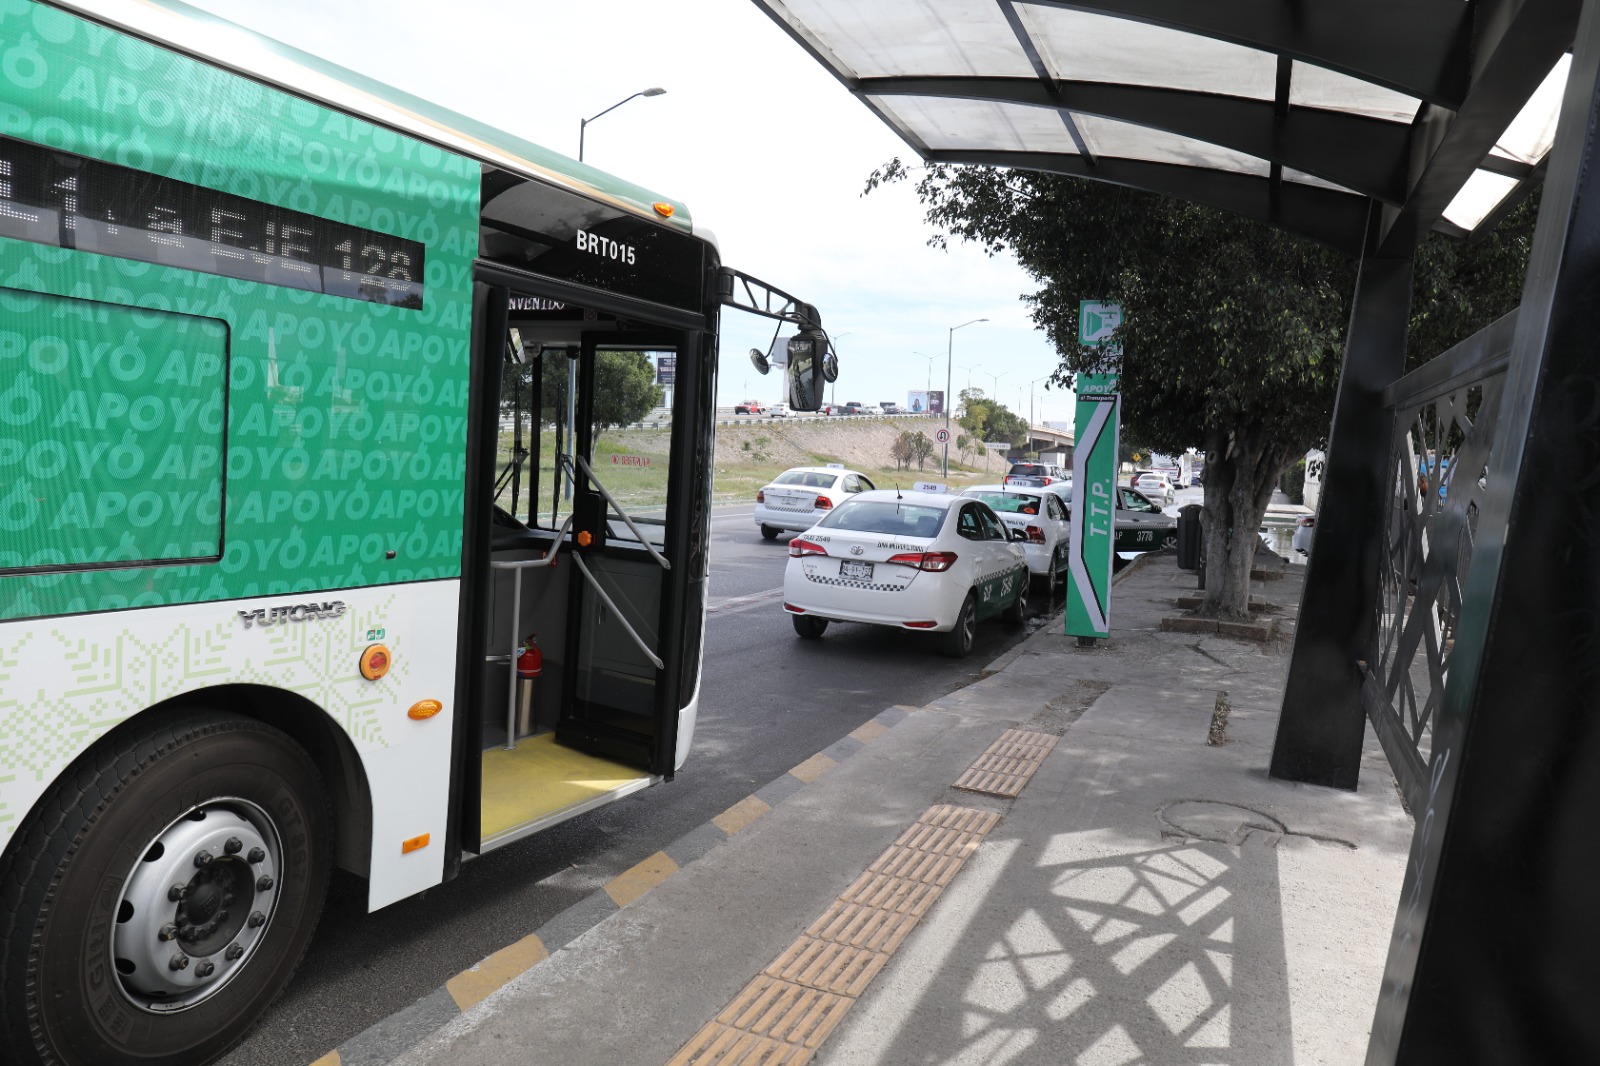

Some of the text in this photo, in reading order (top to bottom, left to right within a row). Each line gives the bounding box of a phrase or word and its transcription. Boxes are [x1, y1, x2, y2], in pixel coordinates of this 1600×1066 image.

[211, 207, 313, 273] EJE
[334, 238, 412, 292] 128
[576, 229, 636, 265] BRT015
[1090, 478, 1110, 537] T.T.P.
[815, 535, 831, 543] 2549
[1136, 530, 1153, 542] 3778
[238, 600, 347, 629] YUTONG
